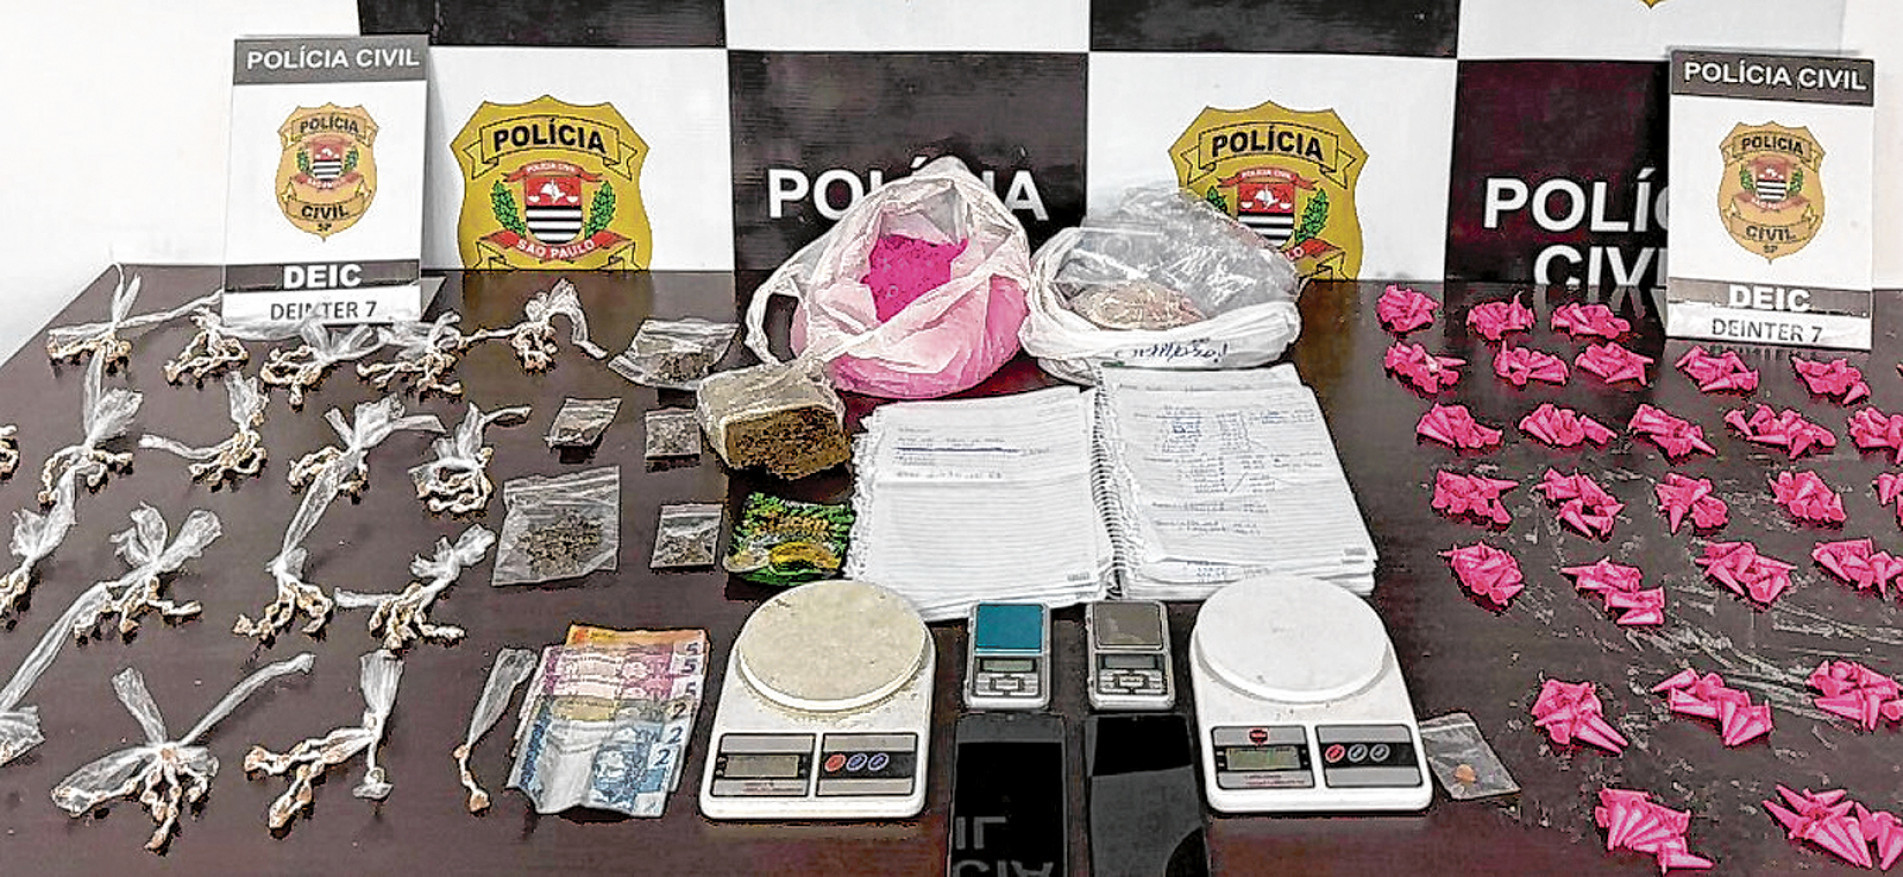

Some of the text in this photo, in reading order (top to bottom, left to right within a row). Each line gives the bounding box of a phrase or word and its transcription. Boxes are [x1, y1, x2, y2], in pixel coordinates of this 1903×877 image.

[247, 45, 420, 70] POLÍCIA CIVIL
[1684, 59, 1867, 90] POLÍCIA CIVIL
[493, 118, 606, 153] POLÍCIA
[1211, 125, 1324, 161] POLÍCIA
[768, 156, 1049, 221] POIA
[1483, 167, 1668, 232] POLÍ
[301, 204, 349, 219] CIVIL
[1745, 225, 1797, 242] CIVIL
[550, 239, 597, 259] PAULO
[283, 263, 363, 289] DEIC
[365, 300, 378, 318] 7
[1728, 284, 1811, 312] DEIC
[1711, 317, 1823, 343] DEINTER 7
[681, 658, 696, 674] 5
[666, 726, 683, 745] 2
[654, 748, 671, 767] 2
